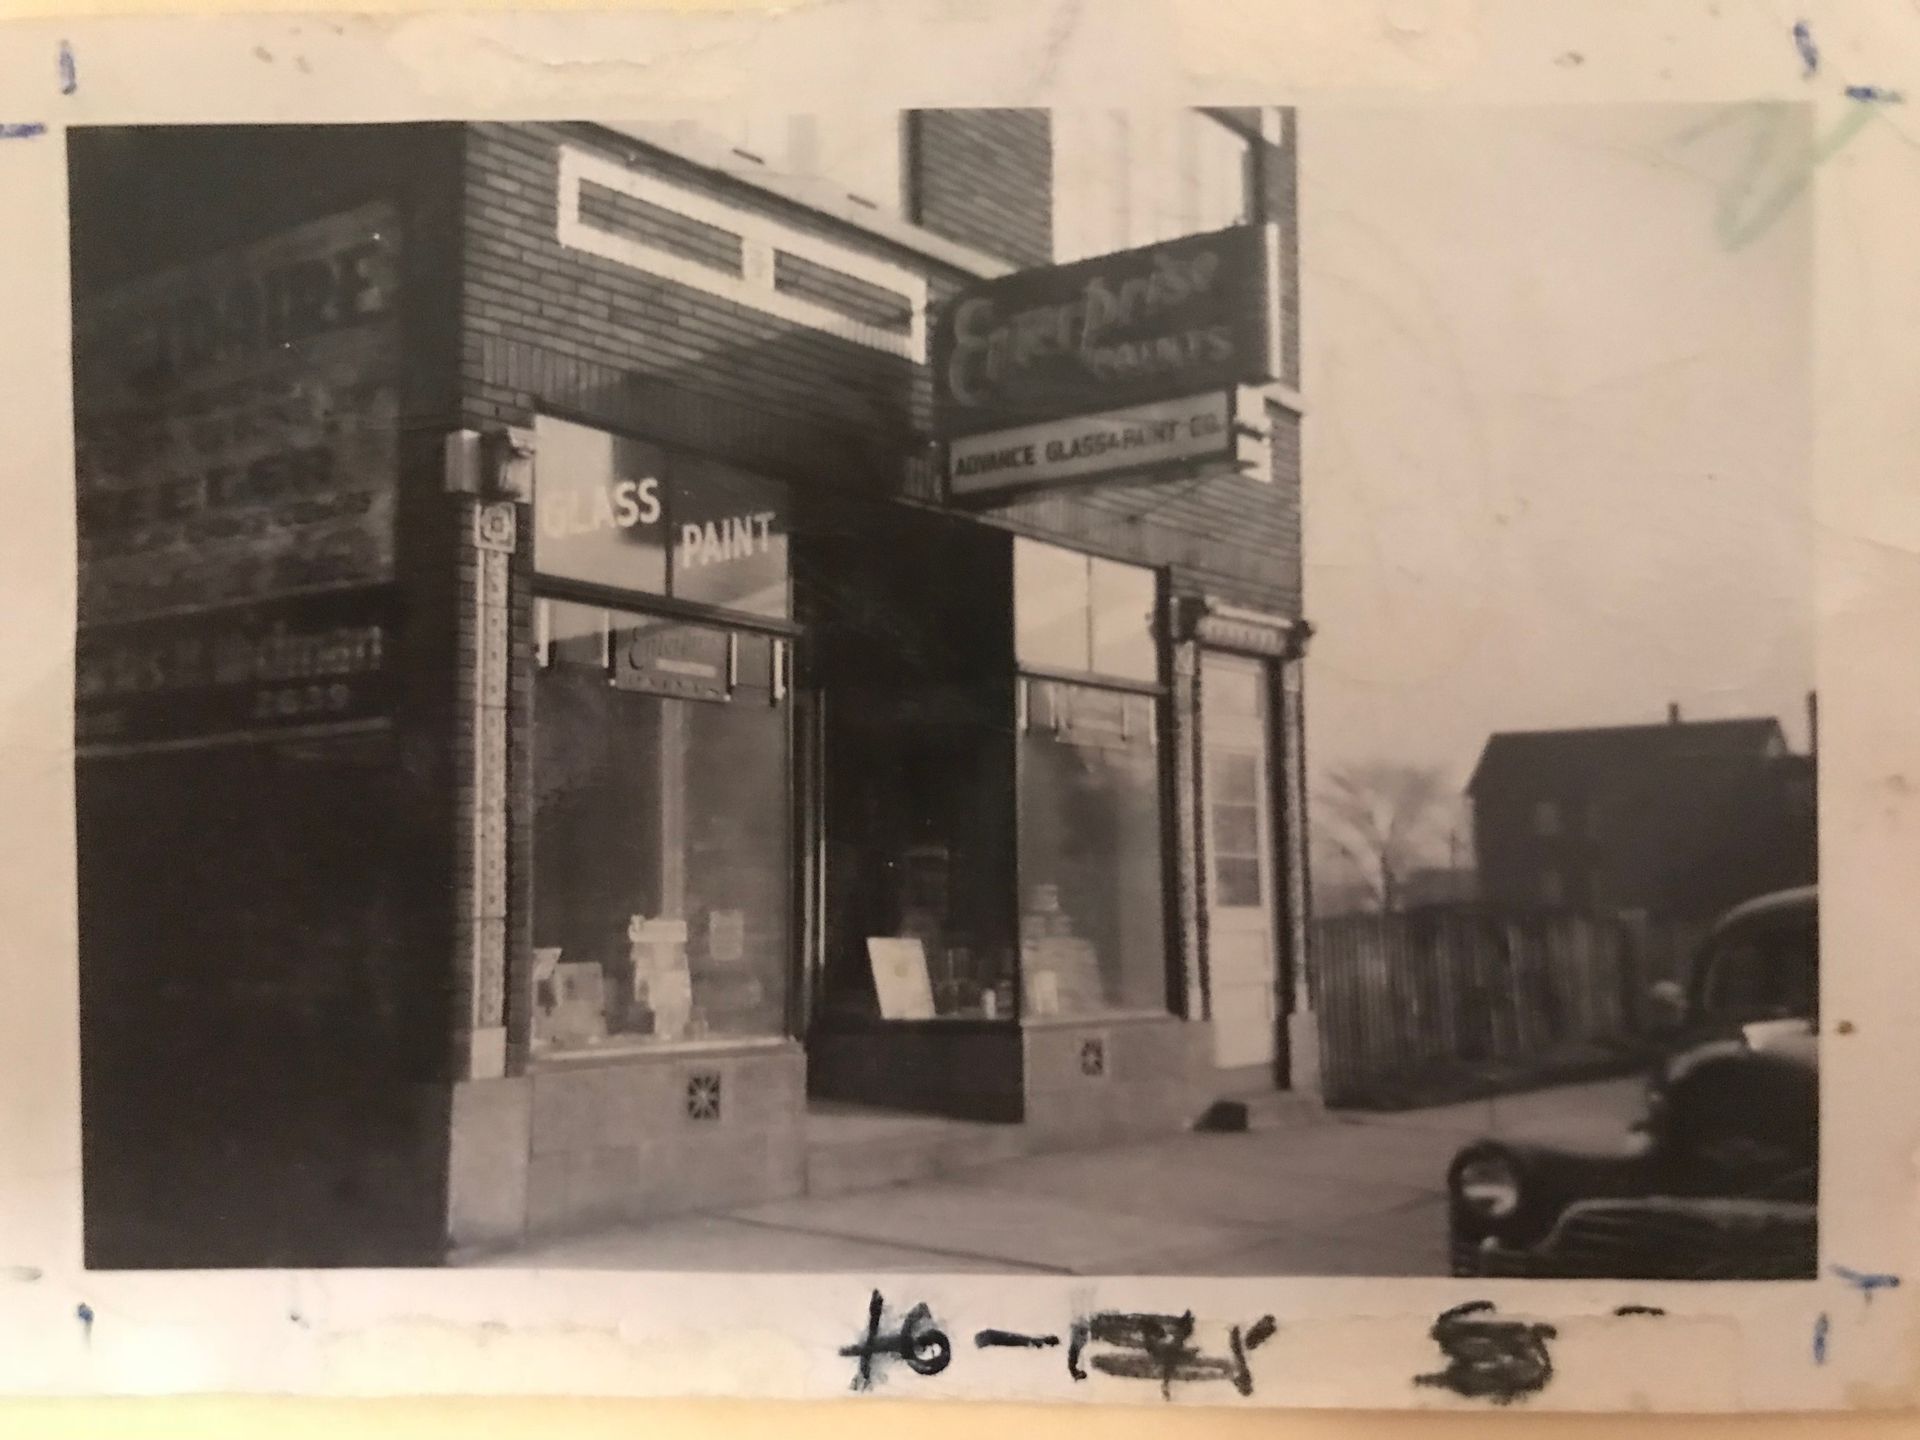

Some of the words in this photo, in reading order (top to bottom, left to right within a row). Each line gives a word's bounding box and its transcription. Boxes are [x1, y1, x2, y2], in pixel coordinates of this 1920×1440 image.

[955, 444, 1035, 476] ADVANCE
[542, 477, 661, 540] GLASS
[681, 511, 777, 569] PAINT
